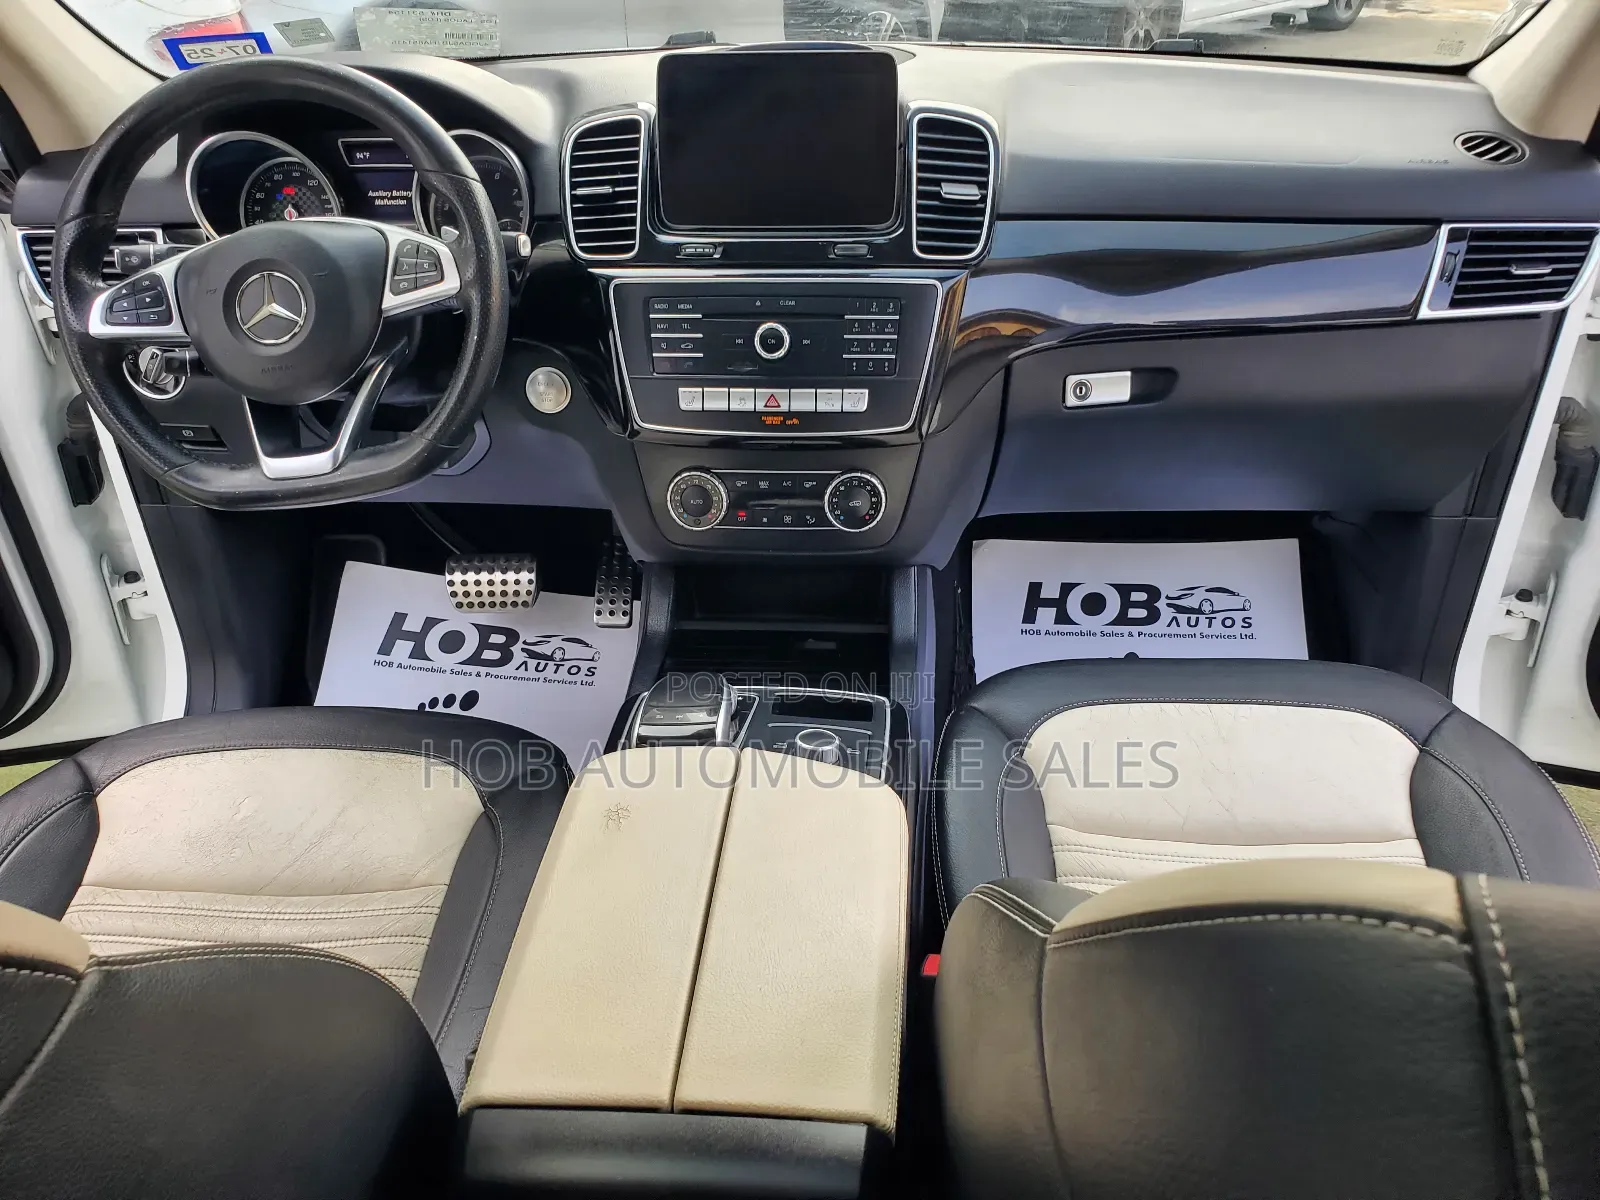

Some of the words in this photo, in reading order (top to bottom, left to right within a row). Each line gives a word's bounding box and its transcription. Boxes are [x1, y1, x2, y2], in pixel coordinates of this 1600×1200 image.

[1021, 581, 1162, 627] HOB
[1020, 628, 1042, 636] HOB
[1044, 629, 1098, 638] Automobile
[1099, 630, 1125, 638] Sales
[1127, 630, 1134, 638] &
[1137, 631, 1197, 640] Procurement
[1199, 631, 1237, 640] Services
[1239, 632, 1257, 640] Ltd.
[1166, 616, 1253, 629] AUTOS
[376, 611, 521, 668] HOB
[373, 658, 395, 669] HOB
[396, 661, 447, 676] Automobile
[449, 667, 473, 678] Sales
[475, 670, 482, 678] &
[484, 671, 541, 684] Procurement
[542, 676, 578, 686] Services
[580, 678, 596, 687] Ltd.
[514, 659, 598, 677] AUTOS
